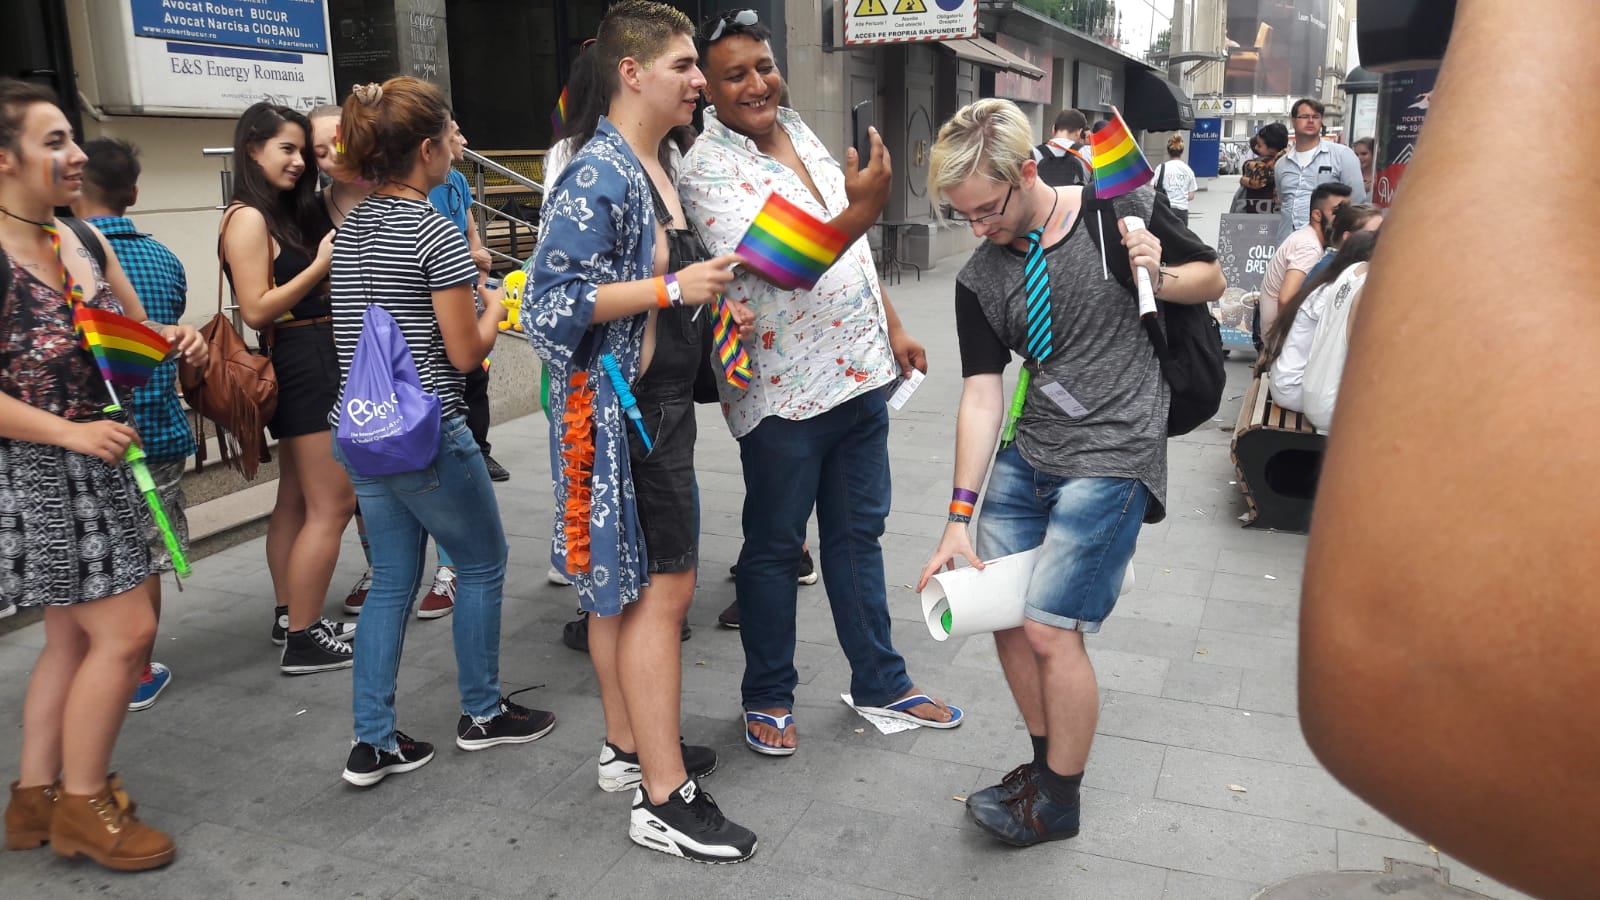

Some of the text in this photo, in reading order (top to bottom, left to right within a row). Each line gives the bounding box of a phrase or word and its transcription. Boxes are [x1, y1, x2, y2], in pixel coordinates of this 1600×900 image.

[162, 0, 288, 23] Avocat Robert BUCUR
[142, 25, 217, 39] www.robertbucur.ro
[164, 12, 301, 38] Avocat Narcisa CIOBANU
[919, 27, 967, 35] RASPUNDERE!
[171, 57, 305, 82] E&S Energy Romania
[1249, 245, 1276, 260] COLD
